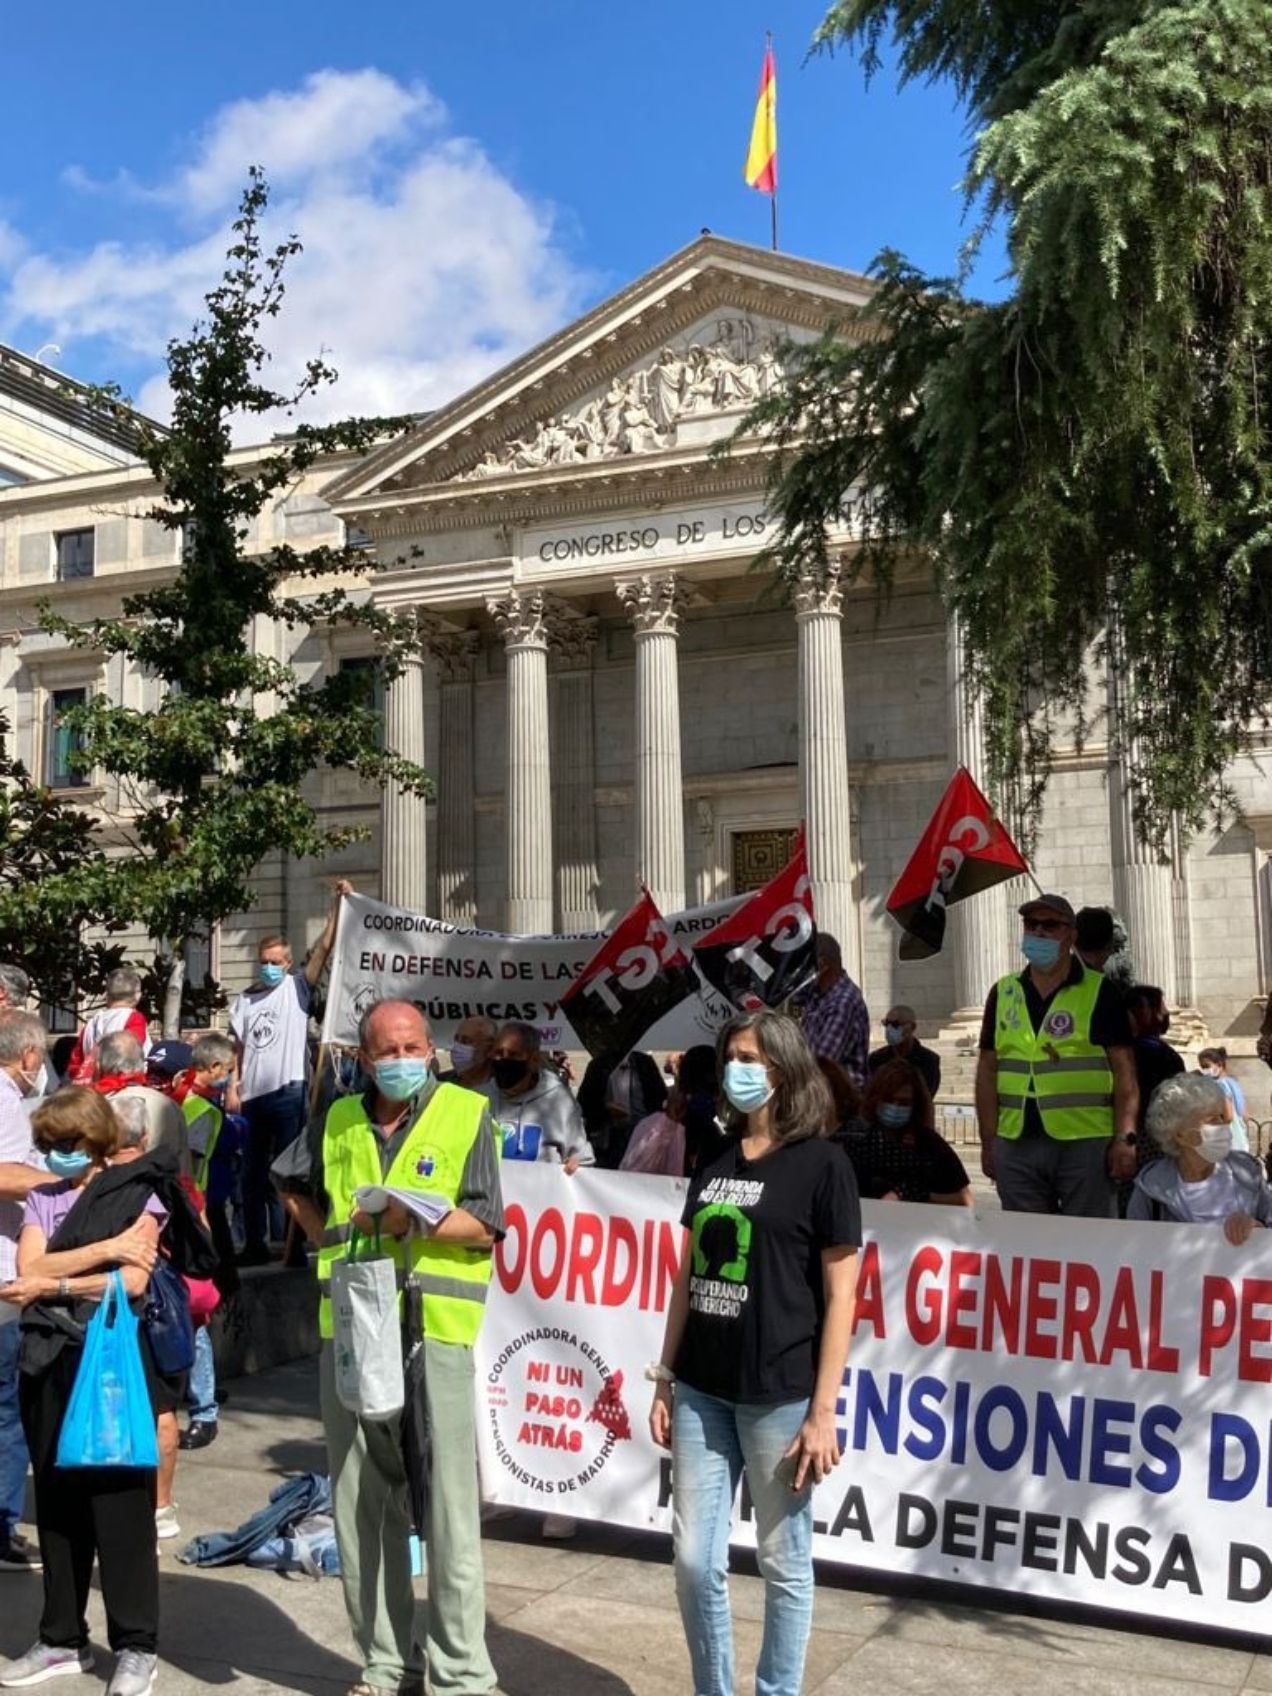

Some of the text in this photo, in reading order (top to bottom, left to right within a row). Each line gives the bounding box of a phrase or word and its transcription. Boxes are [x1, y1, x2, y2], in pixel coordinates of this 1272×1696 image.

[539, 514, 766, 563] CONGRESO DE LOS
[359, 951, 387, 972] EN
[392, 955, 493, 980] DEFENSA
[501, 961, 534, 980] DE
[542, 1002, 560, 1020] Y
[905, 1245, 1180, 1374] GENERAL
[488, 1327, 578, 1383] COORDINADORA
[527, 1361, 584, 1388] NI UN
[525, 1392, 582, 1419] PASO
[517, 1422, 583, 1453] ATRÁS
[557, 1478, 578, 1493] DE
[579, 1429, 618, 1487] MADRID
[1207, 1412, 1272, 1508] D
[894, 1492, 1204, 1596] DEFENSA
